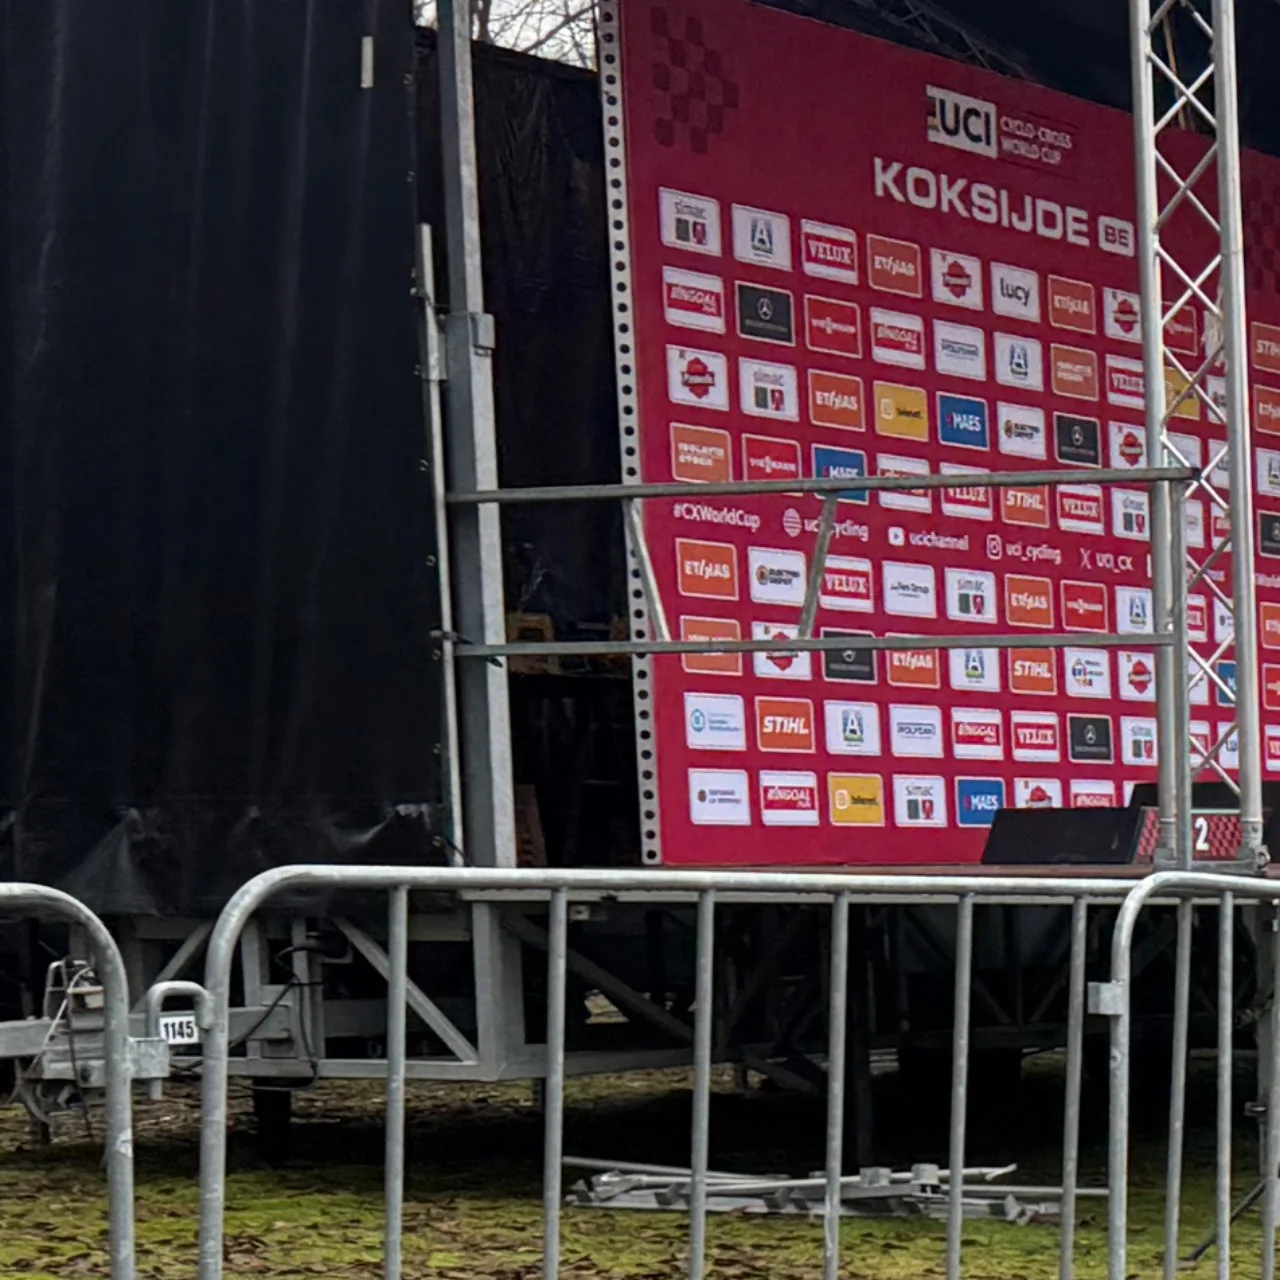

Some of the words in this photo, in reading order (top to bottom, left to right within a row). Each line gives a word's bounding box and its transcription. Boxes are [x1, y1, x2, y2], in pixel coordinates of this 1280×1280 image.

[939, 101, 991, 147] UCI
[1002, 138, 1040, 157] WORLD
[1041, 149, 1061, 165] CUP
[873, 157, 1090, 247] KOKSIJDE
[1103, 225, 1130, 248] BE
[807, 238, 852, 264] VELUX
[1000, 277, 1031, 307] lucy
[952, 411, 983, 432] MAES
[1006, 490, 1044, 510] STIHL
[673, 503, 761, 533] #CXWorldCup
[909, 530, 969, 551] ucichannel
[1005, 541, 1062, 565] uci_cycling
[824, 573, 867, 593] VELUX
[1013, 660, 1052, 678] STIHL
[763, 716, 809, 734] STIHL
[1017, 727, 1054, 745] VELUX
[970, 794, 998, 811] MAES
[1195, 817, 1209, 850] 2
[164, 1021, 194, 1039] 1145
